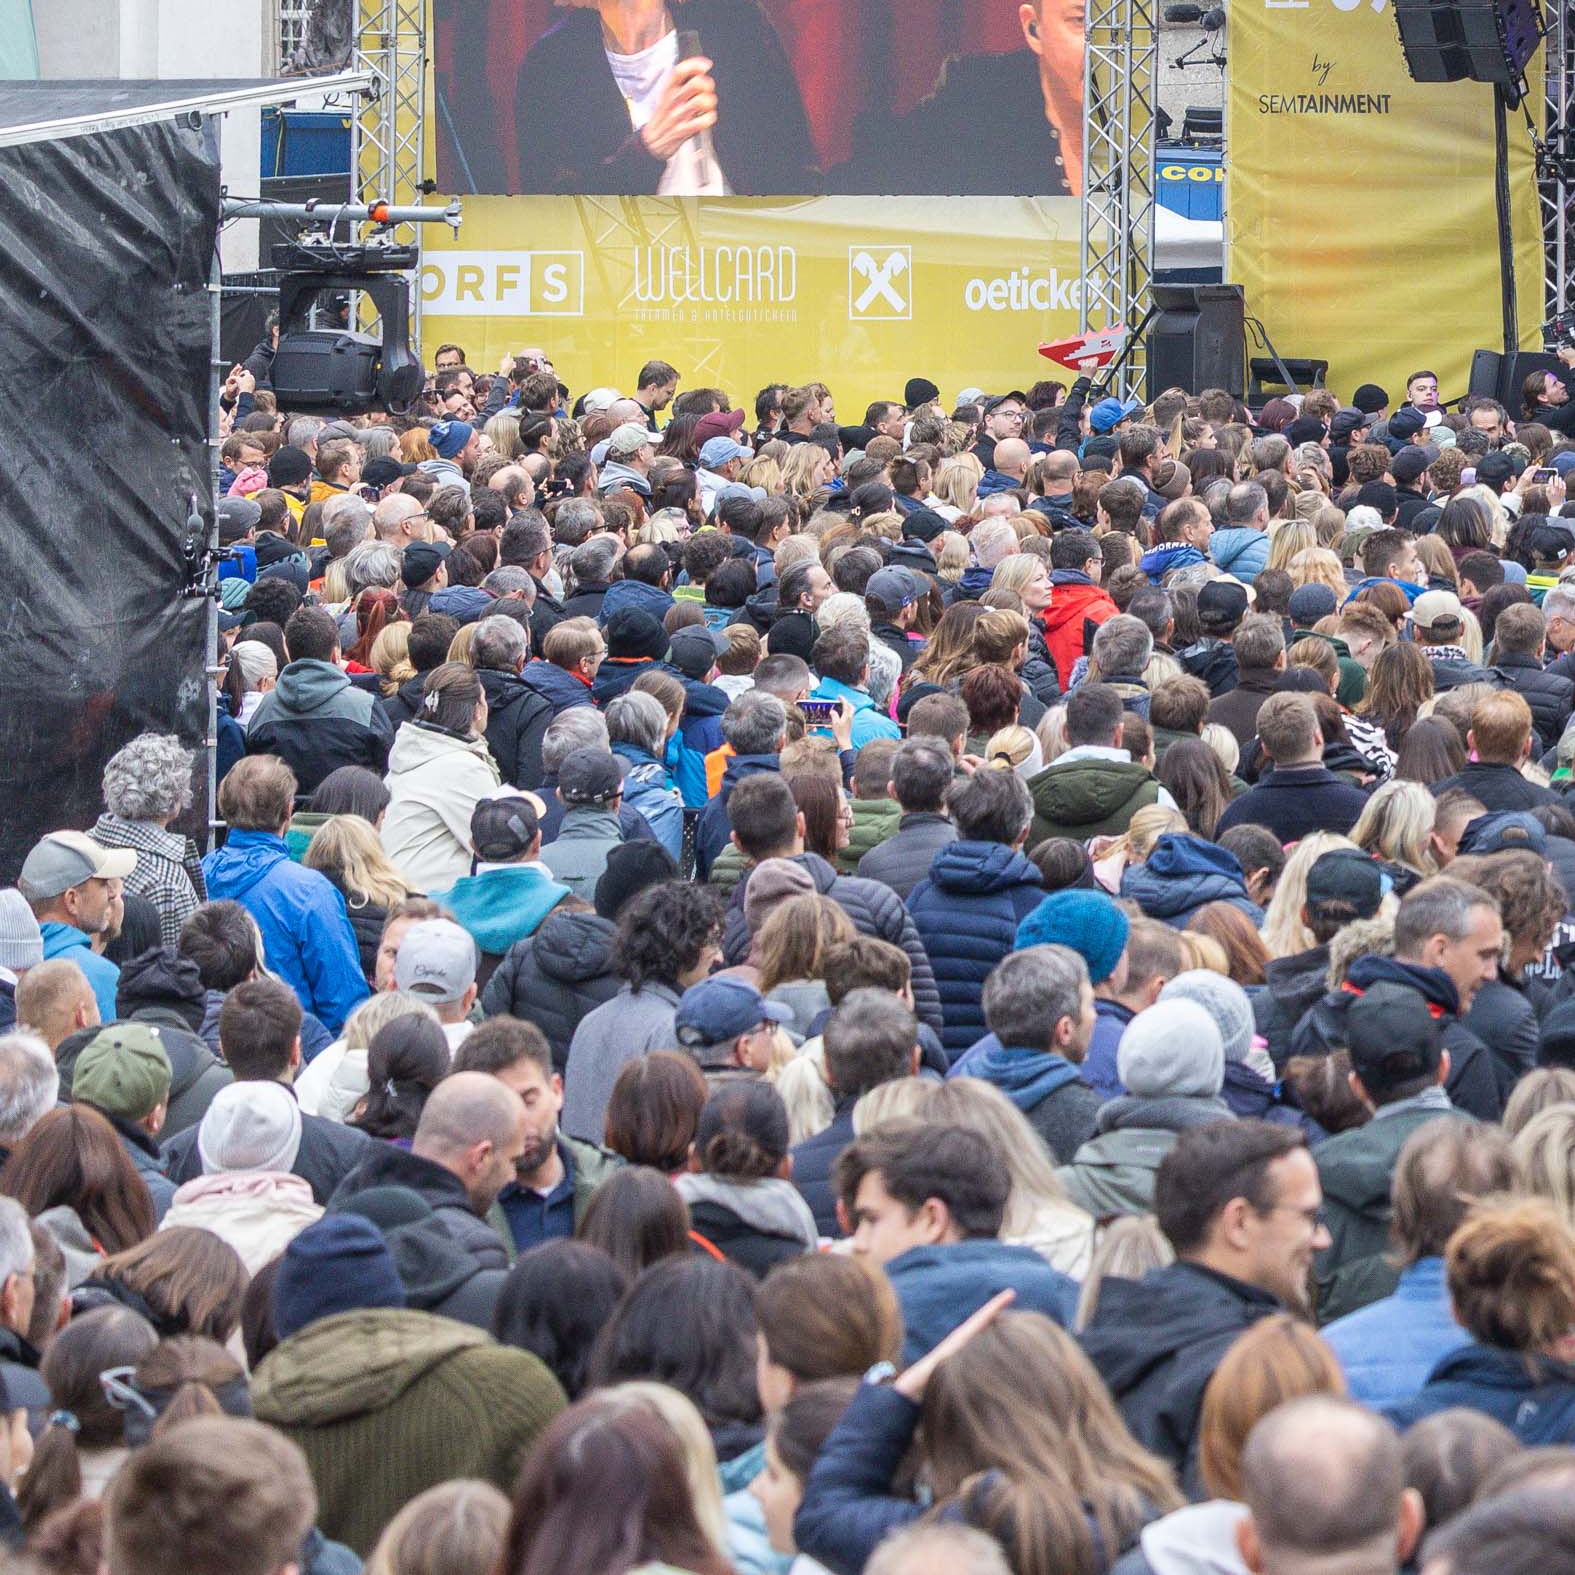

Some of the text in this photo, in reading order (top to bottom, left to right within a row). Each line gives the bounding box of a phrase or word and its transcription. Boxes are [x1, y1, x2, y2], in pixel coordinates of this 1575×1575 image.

[1311, 53, 1337, 86] by
[1258, 94, 1392, 114] SEMTAINMENT
[542, 264, 568, 303] S
[633, 244, 797, 303] WELLCARD
[963, 266, 1102, 311] oeticket
